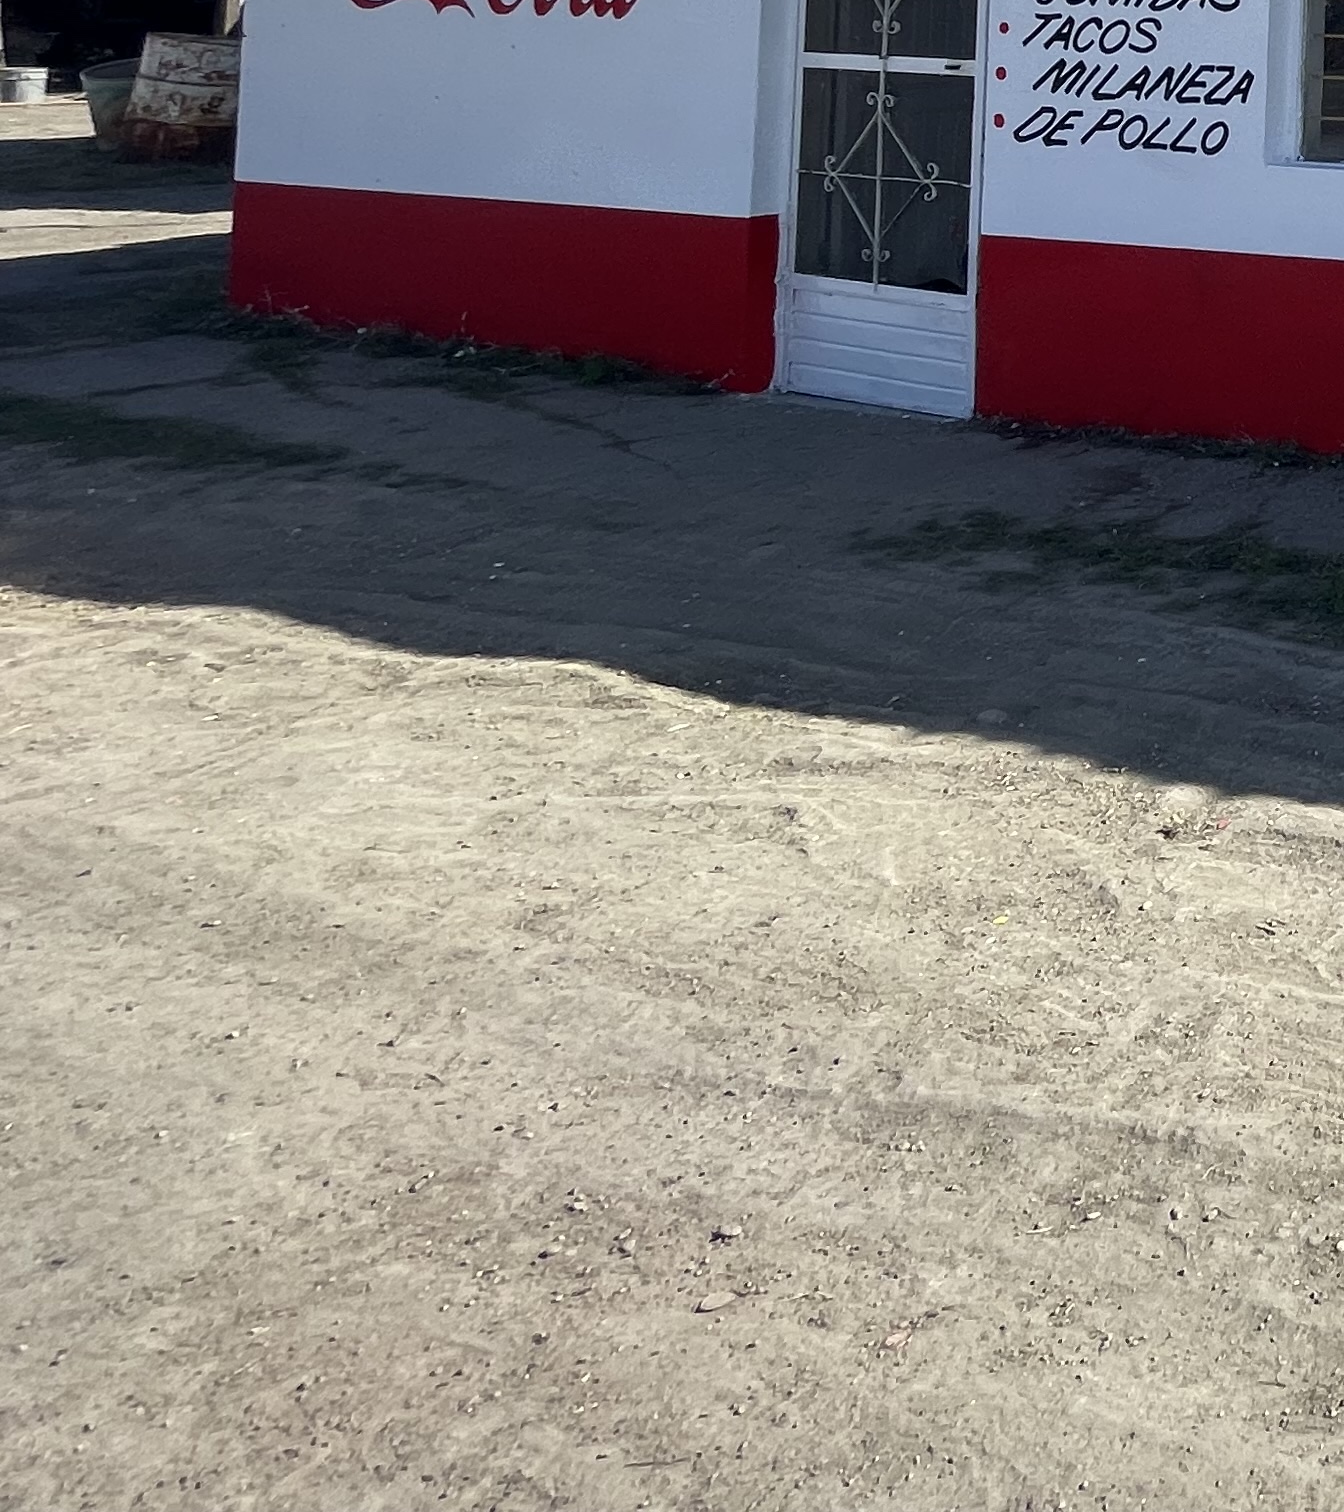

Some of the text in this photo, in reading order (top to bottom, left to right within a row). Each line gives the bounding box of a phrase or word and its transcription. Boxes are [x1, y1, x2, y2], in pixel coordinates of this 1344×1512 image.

[1022, 13, 1163, 54] TACOS
[1032, 58, 1256, 106] MILANEZA
[1013, 106, 1230, 156] DE POLLO
